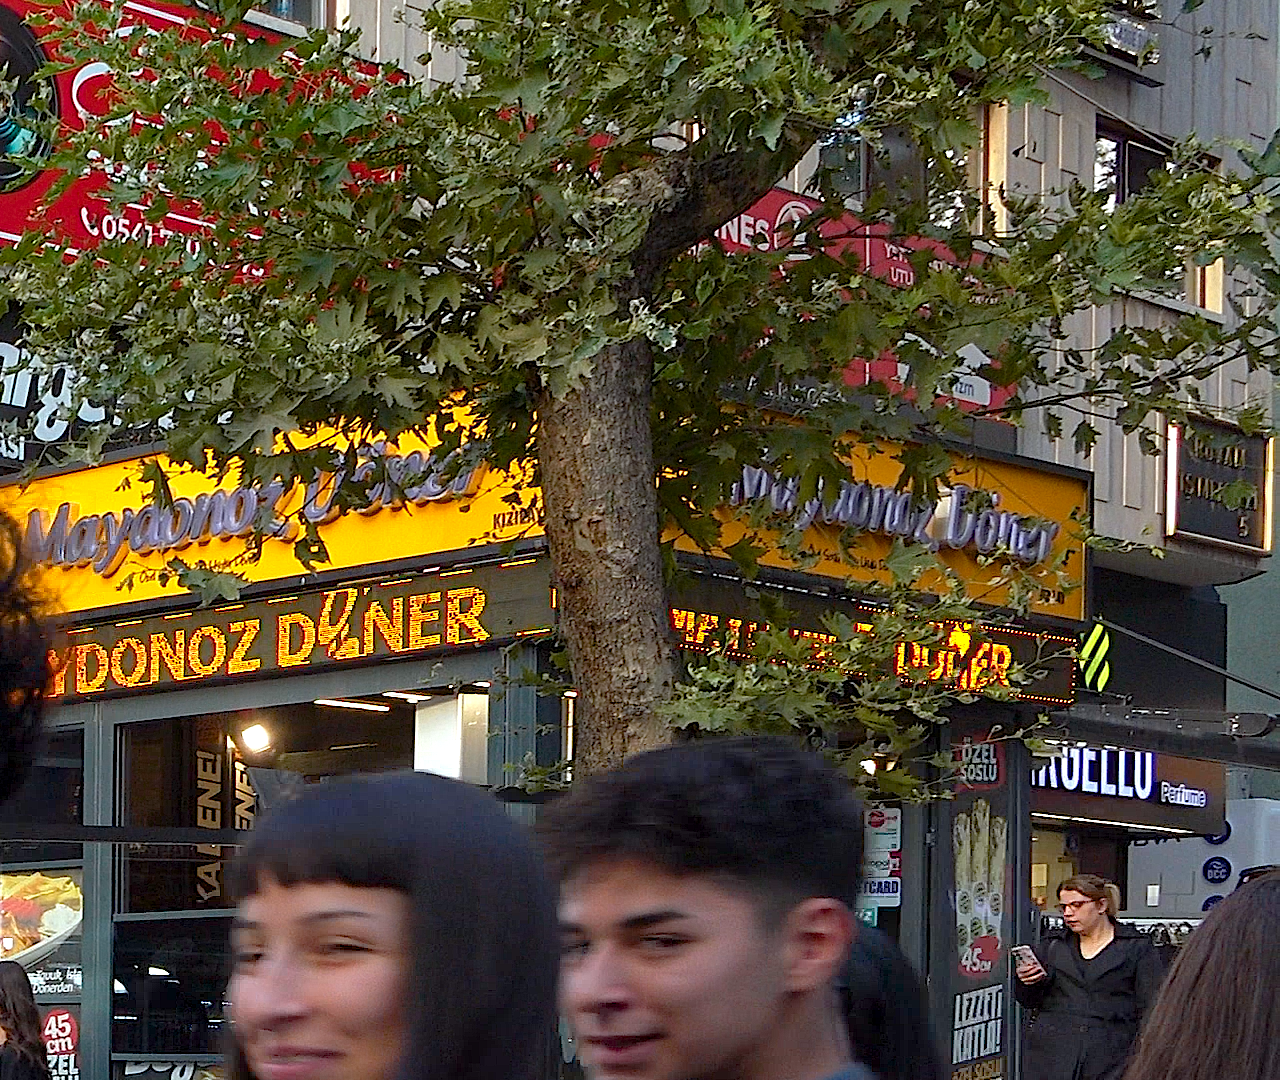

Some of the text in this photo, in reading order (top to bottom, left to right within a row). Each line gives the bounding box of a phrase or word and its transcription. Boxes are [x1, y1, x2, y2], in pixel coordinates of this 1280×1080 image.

[1161, 781, 1207, 808] Perfume
[44, 1012, 73, 1040] 45
[46, 1034, 74, 1054] cm
